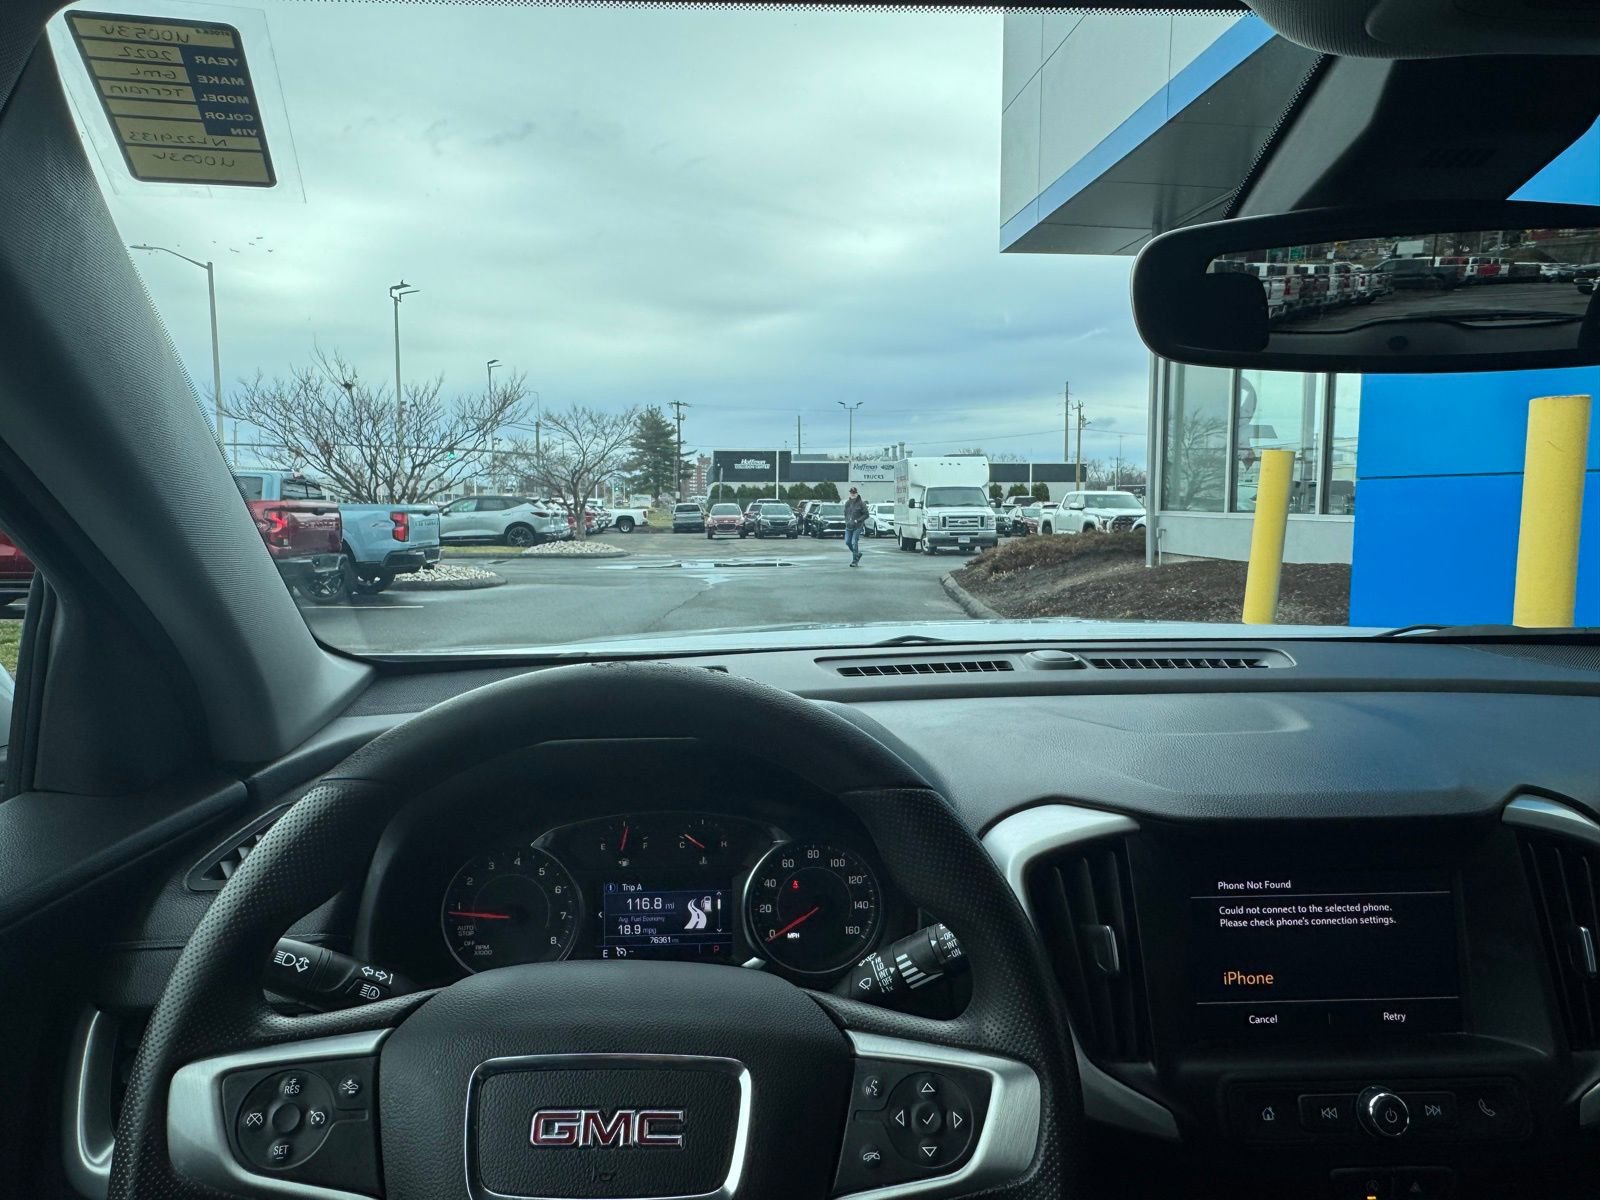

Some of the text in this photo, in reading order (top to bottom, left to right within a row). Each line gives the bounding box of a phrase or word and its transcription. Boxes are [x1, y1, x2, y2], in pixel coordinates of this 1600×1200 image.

[807, 850, 820, 859] 80
[488, 862, 495, 870] 3
[514, 858, 521, 866] 4
[782, 858, 795, 868] 60
[830, 858, 846, 868] 100
[538, 868, 545, 876] 5
[466, 877, 473, 885] 2
[764, 879, 777, 888] 40
[848, 875, 863, 885] 120
[1217, 880, 1291, 890] Phone Not Found
[555, 886, 561, 894] 6
[622, 883, 642, 892] Trip A
[626, 897, 662, 911] 116.8
[759, 904, 772, 913] 20
[854, 900, 869, 910] 140
[1219, 903, 1393, 915] Could not connect to the selected phone.
[560, 912, 566, 920] 7
[1219, 915, 1397, 928] Please check phone's connection settings.
[618, 925, 641, 935] 18.9
[769, 929, 776, 938] 0
[845, 925, 860, 935] 160
[550, 937, 557, 945] 8
[946, 938, 957, 949] INT
[878, 968, 889, 979] INT
[1223, 971, 1275, 985] iPhone
[881, 975, 893, 986] OFF
[1249, 1014, 1278, 1024] Cancel
[1383, 1012, 1406, 1023] Retry
[284, 1085, 300, 1095] RES
[529, 1110, 684, 1148] GMC
[273, 1145, 289, 1155] SET
